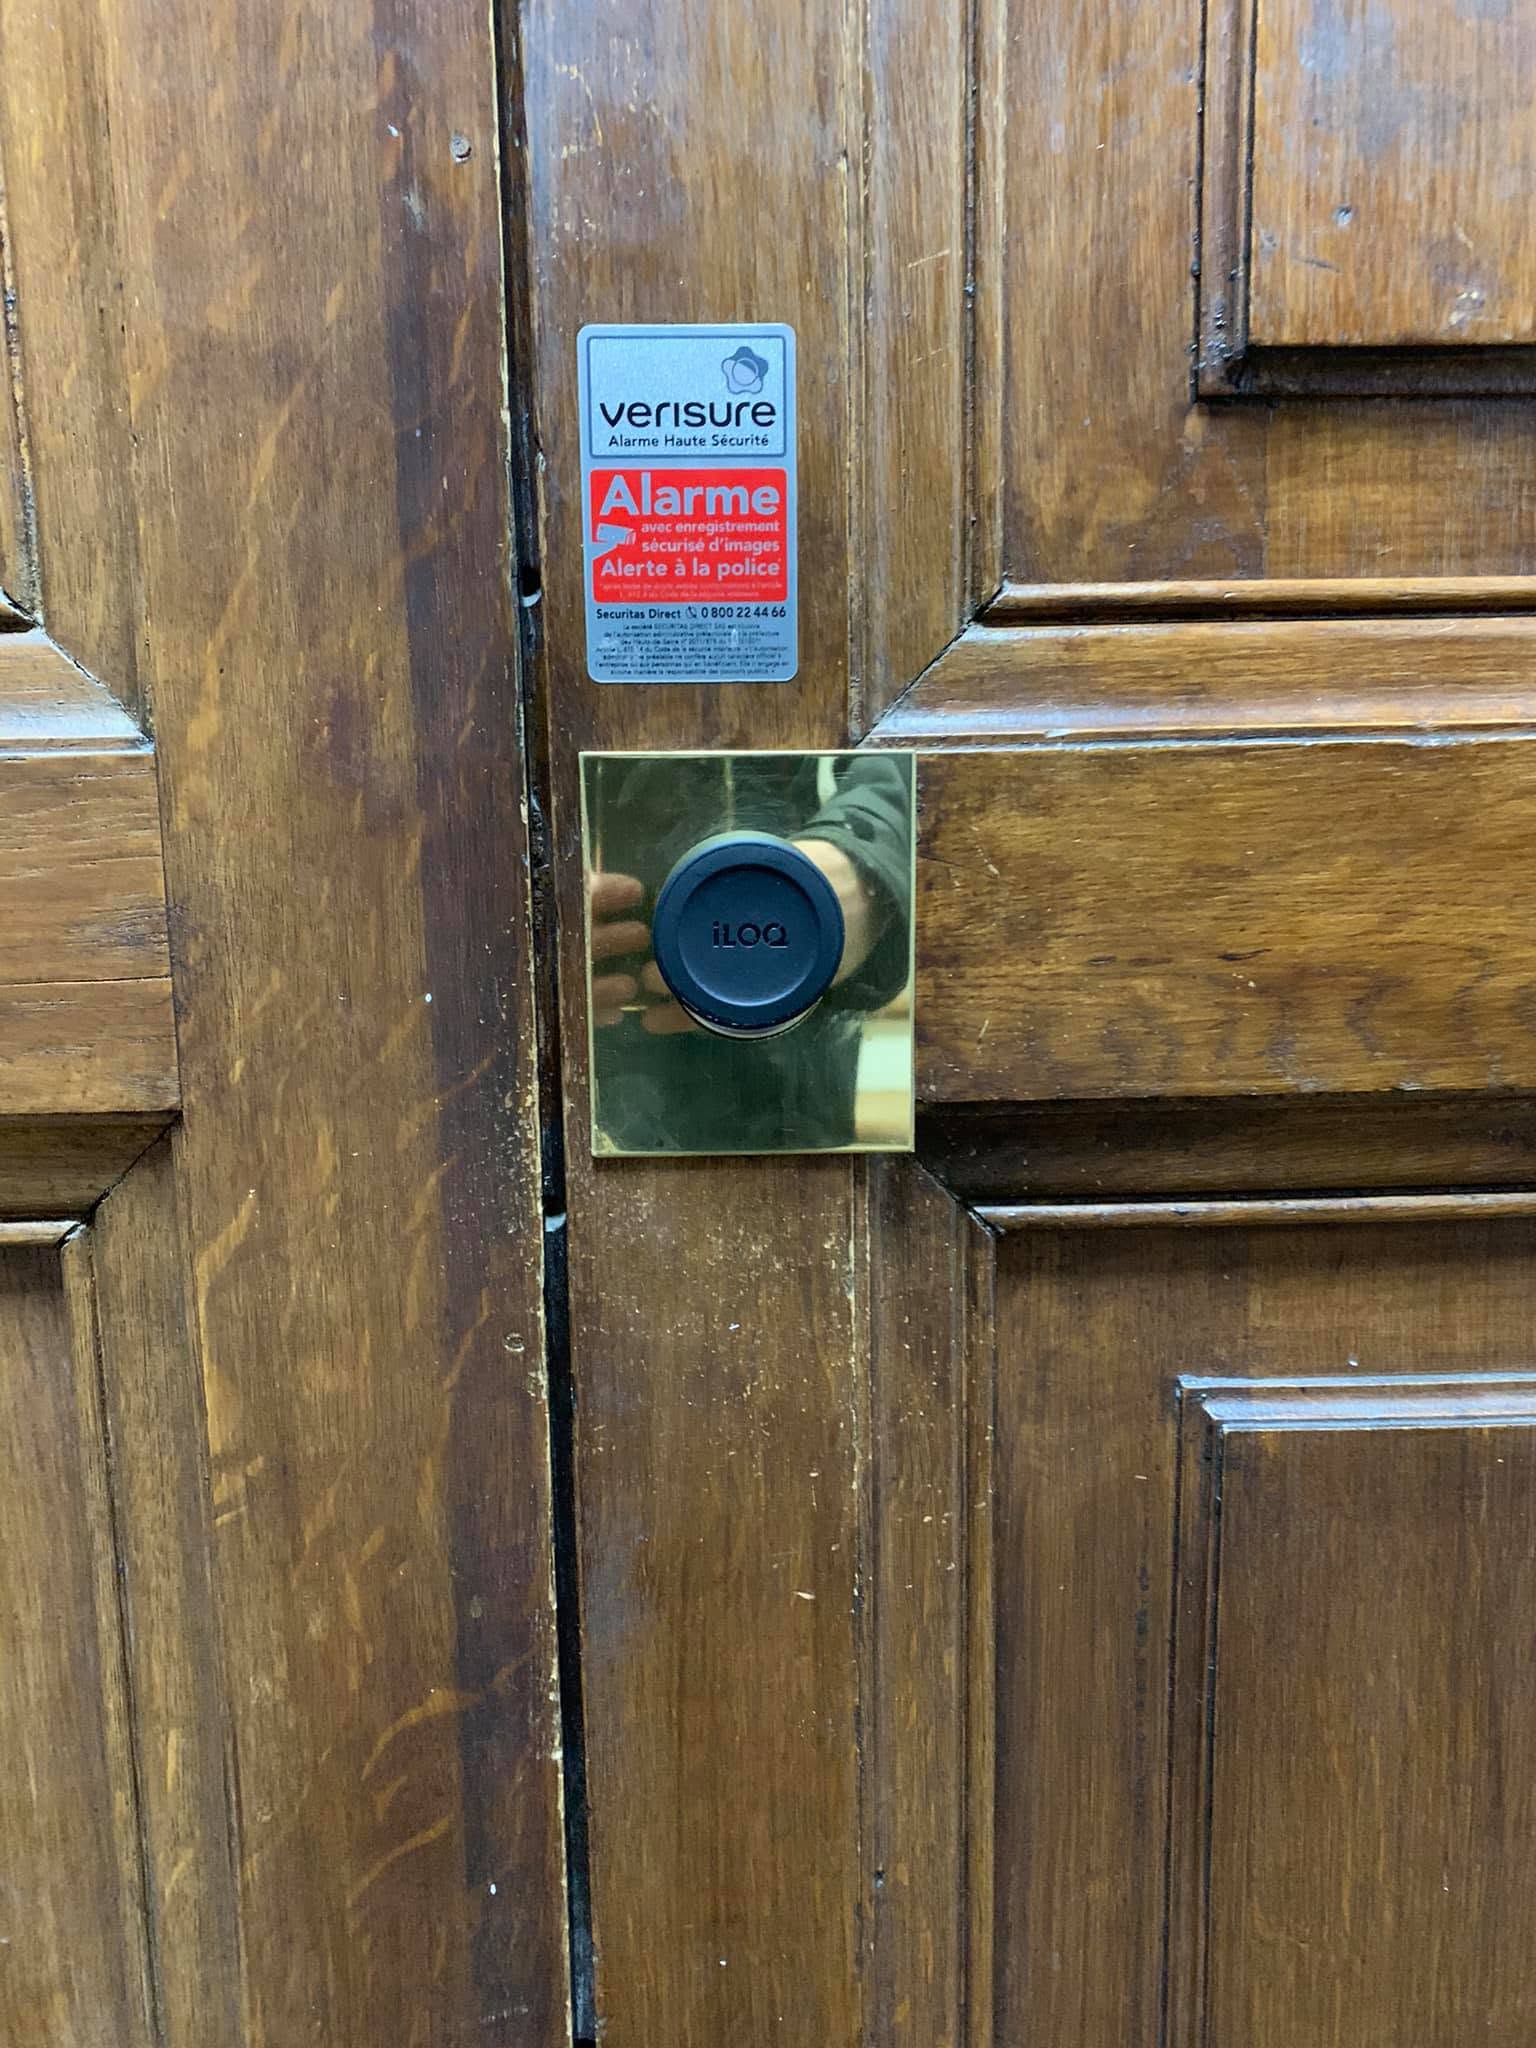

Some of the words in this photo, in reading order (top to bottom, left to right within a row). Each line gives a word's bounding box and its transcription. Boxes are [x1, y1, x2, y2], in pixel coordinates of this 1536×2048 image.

[599, 401, 777, 428] verisure
[608, 434, 659, 447] Alarme
[664, 434, 706, 447] Haute
[711, 433, 769, 447] Sécurité
[599, 472, 781, 517] Alarme
[641, 523, 672, 534] avec
[675, 521, 780, 536] enregistrement
[641, 537, 705, 553] sécurisé
[708, 537, 780, 556] d'images
[600, 558, 668, 577] Alerte
[674, 557, 686, 577] à
[692, 558, 711, 577] la
[596, 607, 646, 620] Securitas
[648, 607, 681, 620] Direct
[701, 606, 709, 619] 0
[711, 606, 734, 618] 800
[736, 606, 751, 618] 22
[753, 605, 769, 618] 44
[771, 605, 787, 618] 66
[712, 920, 789, 949] iLOQ
